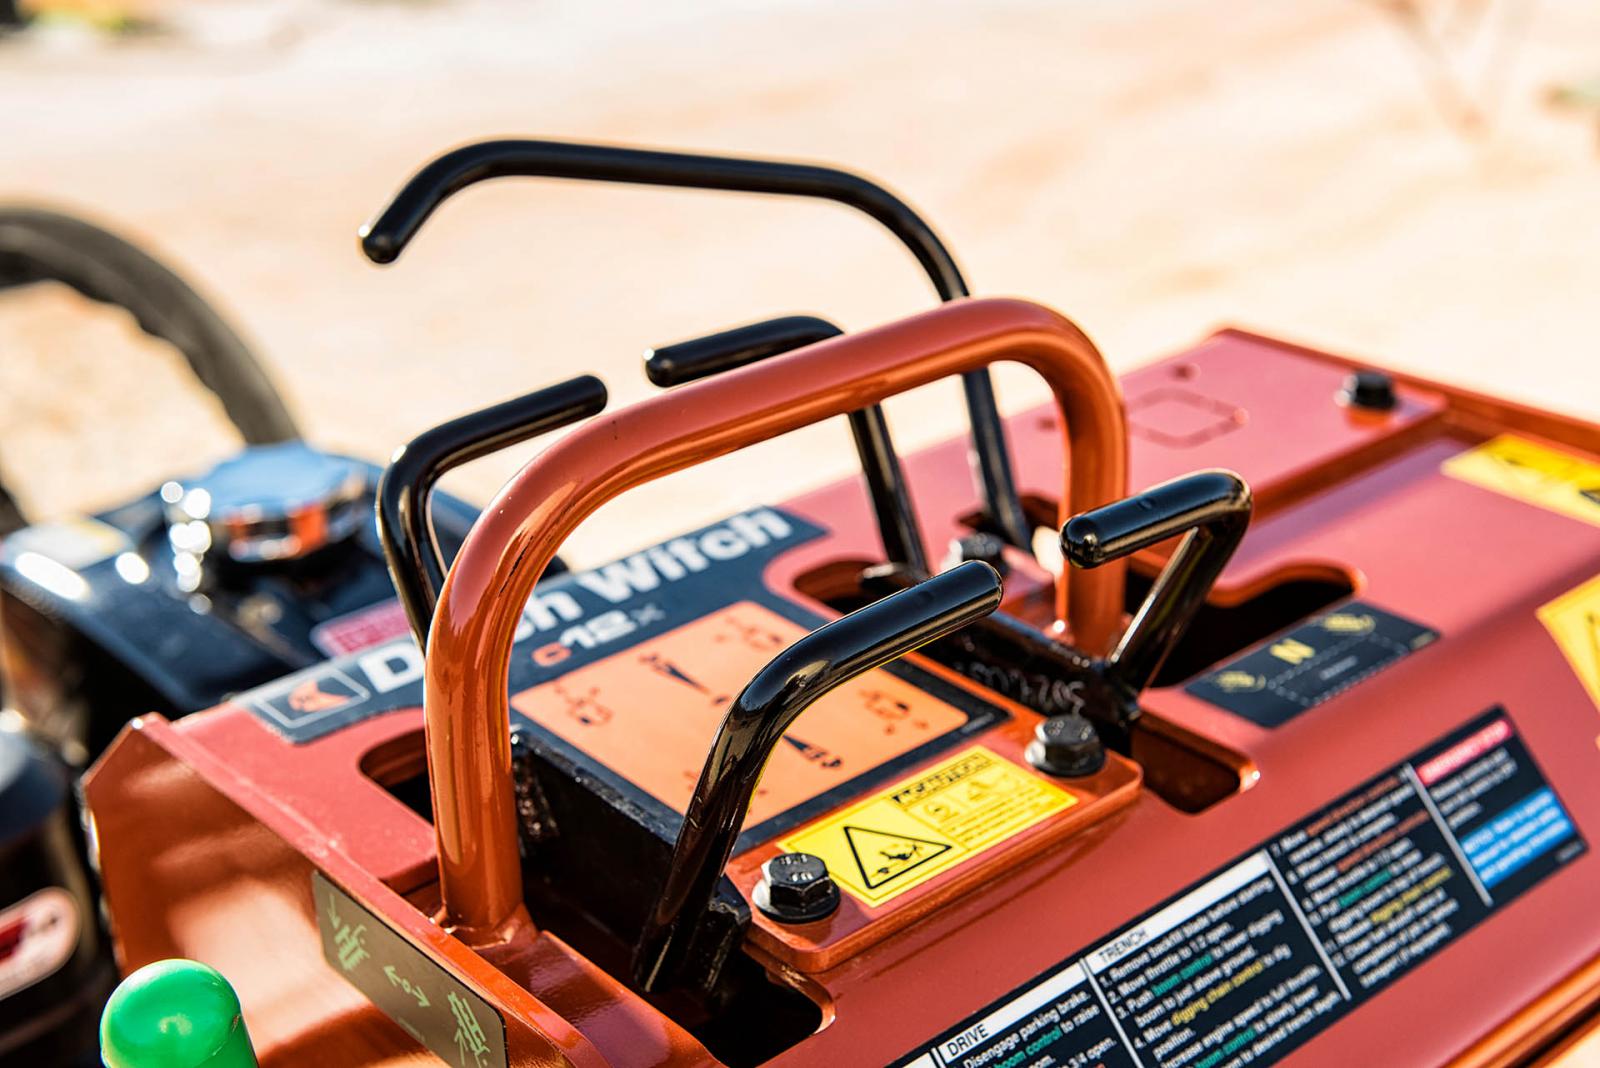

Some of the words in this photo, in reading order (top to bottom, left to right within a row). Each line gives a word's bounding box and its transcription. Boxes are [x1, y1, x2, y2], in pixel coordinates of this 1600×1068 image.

[577, 507, 792, 604] Witch
[1099, 931, 1146, 962] TRENCH
[1109, 952, 1151, 982] Remove
[1148, 930, 1185, 959] backfill
[1182, 916, 1210, 938] blade
[1107, 990, 1121, 1005] 2.
[1117, 975, 1147, 997] Move
[1144, 953, 1181, 981] throttle
[1072, 1004, 1100, 1027] raise
[1115, 1006, 1130, 1020] 3.
[1126, 990, 1155, 1013] Push
[946, 1023, 989, 1057] DRIVE
[962, 1032, 1021, 1068] Disengage
[1019, 1009, 1061, 1042] parking
[1056, 991, 1091, 1015] brake.
[1134, 1037, 1147, 1049] 4.
[1143, 1020, 1173, 1044] Move
